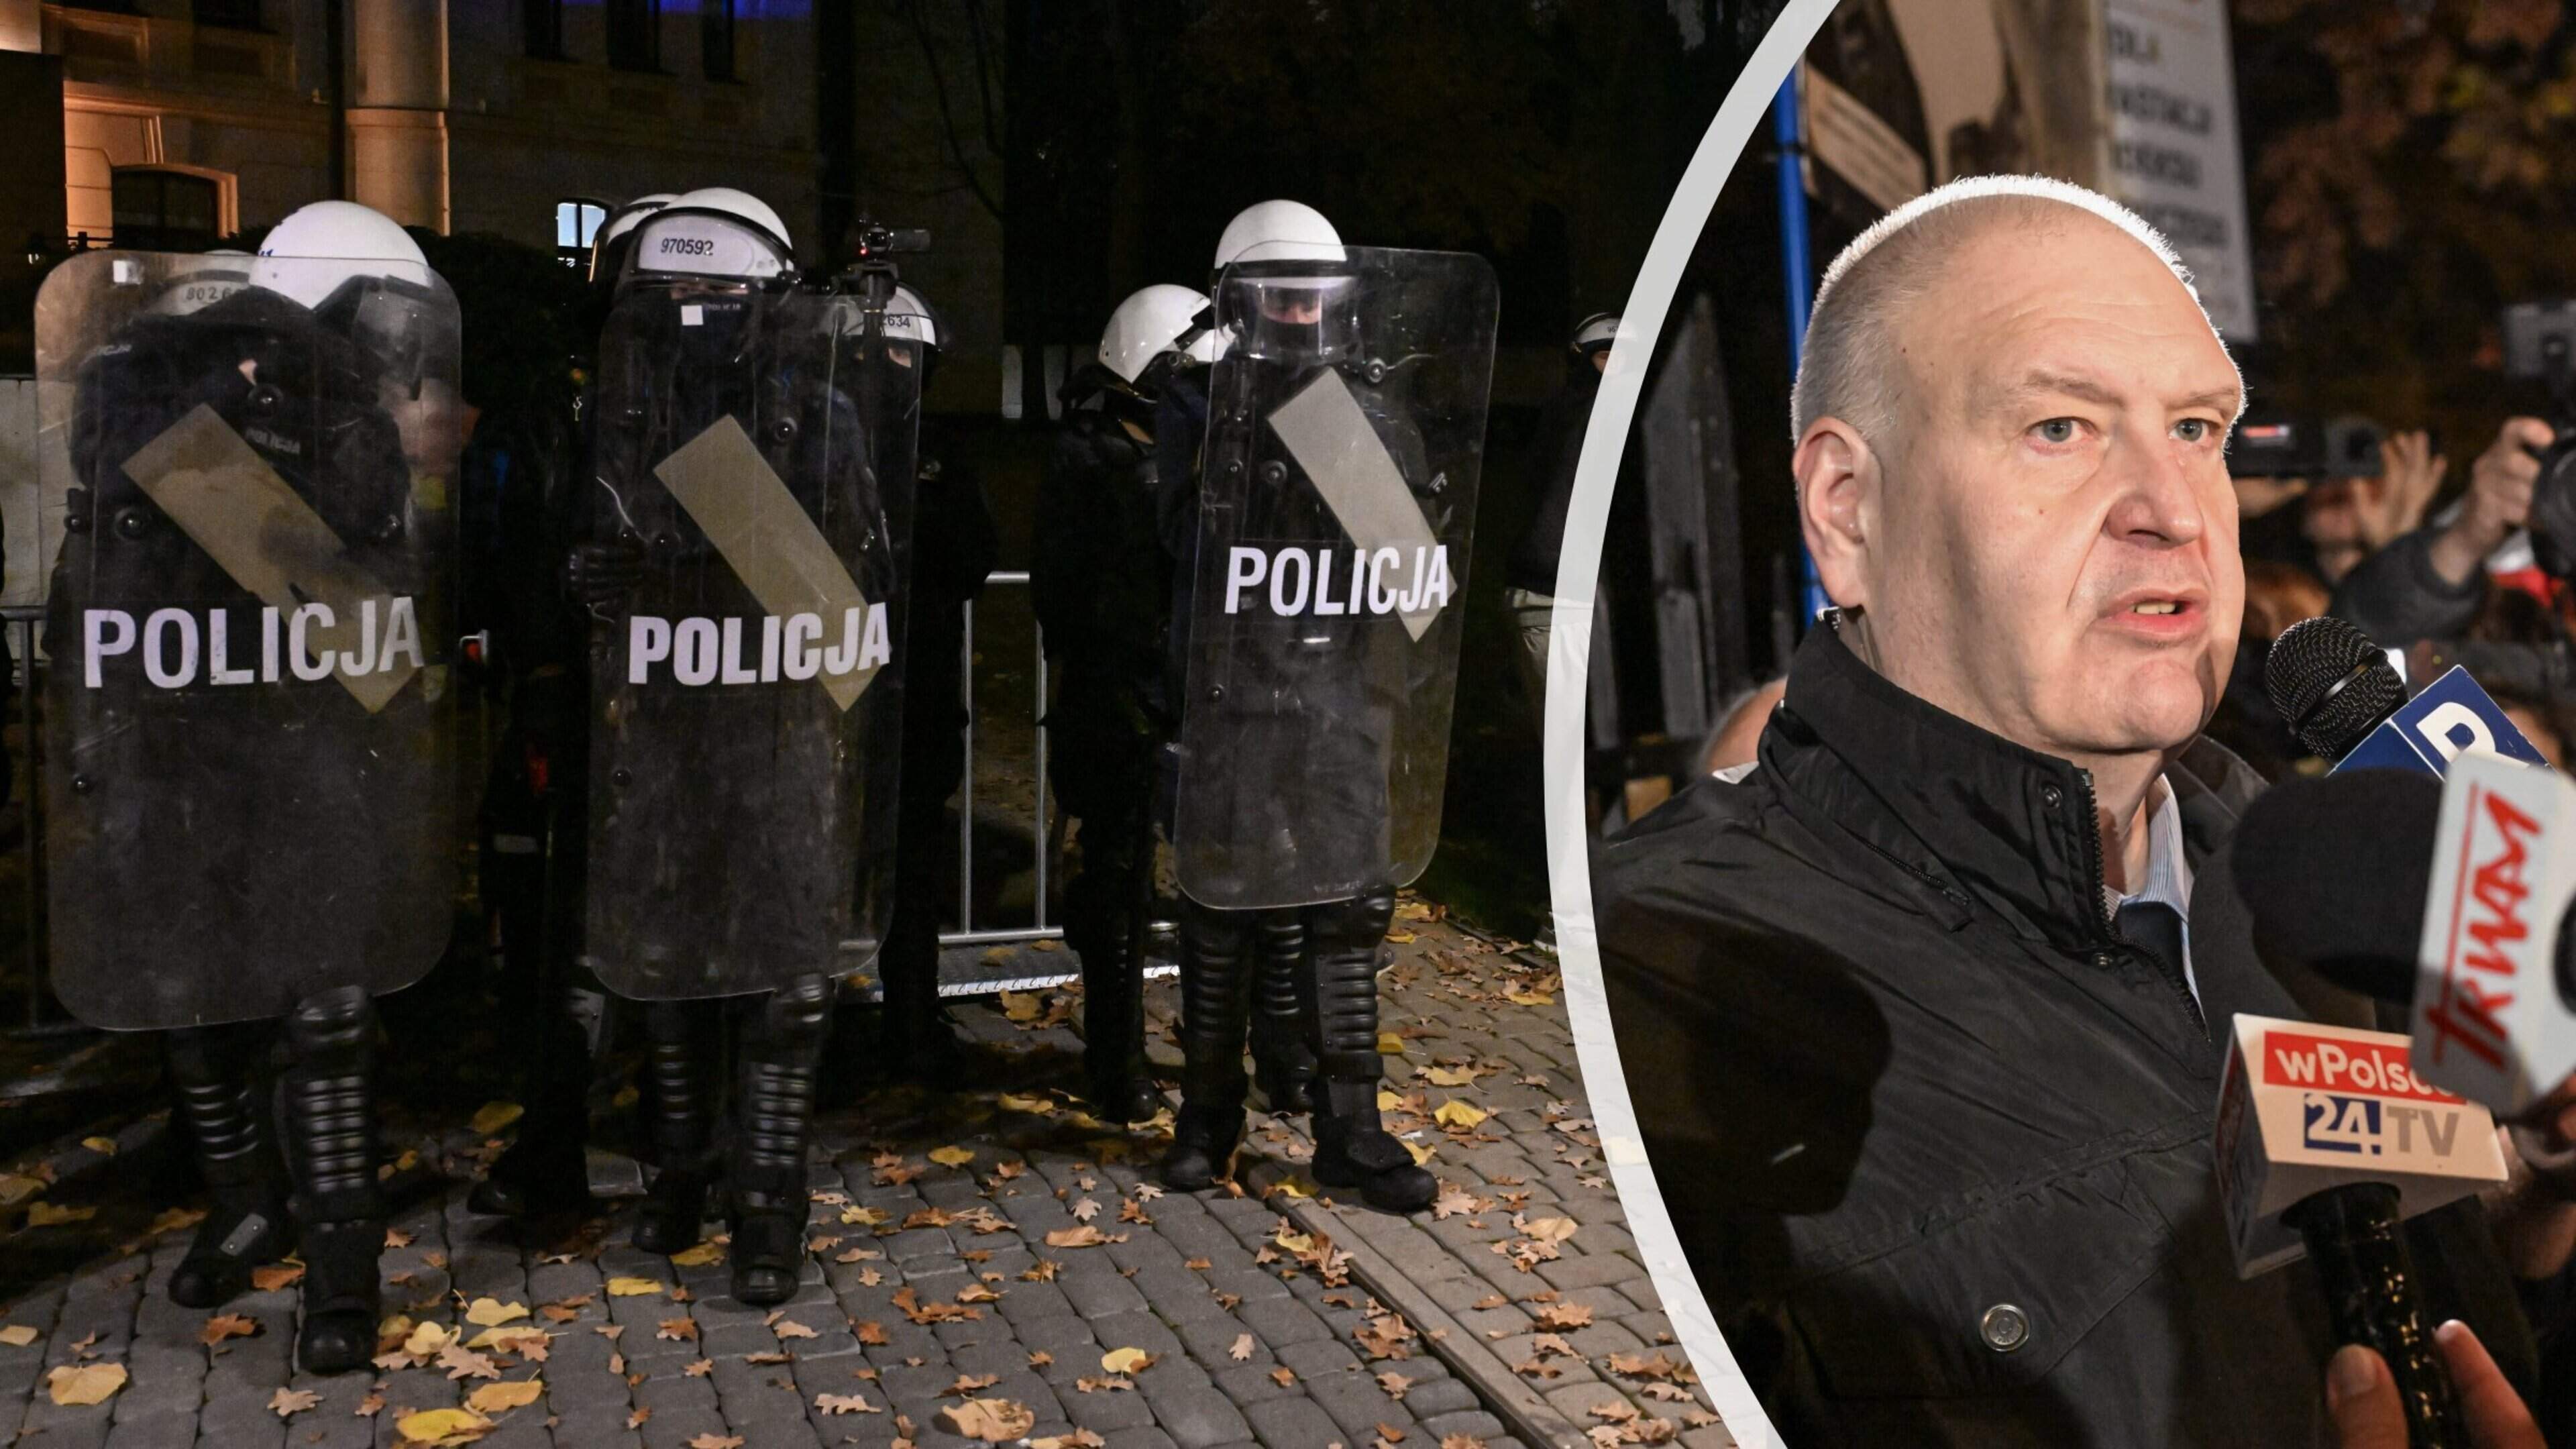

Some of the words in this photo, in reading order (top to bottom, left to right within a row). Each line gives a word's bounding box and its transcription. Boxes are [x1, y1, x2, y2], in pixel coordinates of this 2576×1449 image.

[661, 237, 714, 256] 970592
[882, 315, 911, 328] 634
[1224, 545, 1448, 616] POLICJA
[83, 596, 425, 688] POLICJA
[629, 602, 891, 686] POLICJA
[2275, 1042, 2455, 1096] wPolsc
